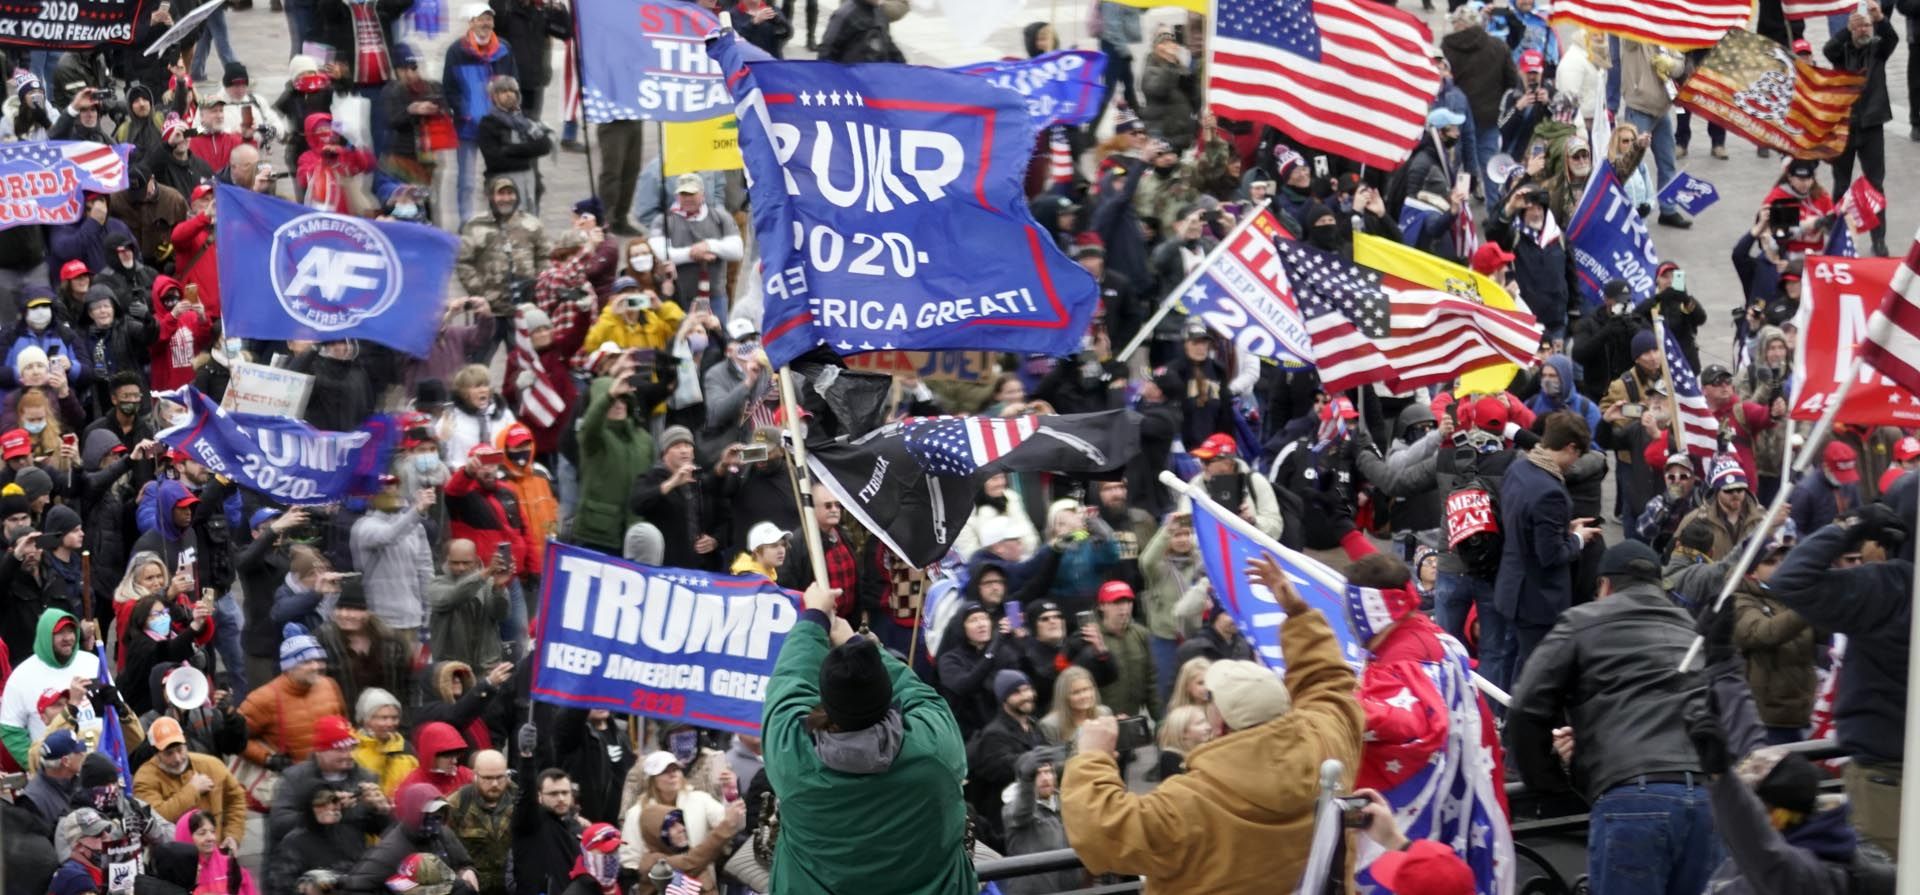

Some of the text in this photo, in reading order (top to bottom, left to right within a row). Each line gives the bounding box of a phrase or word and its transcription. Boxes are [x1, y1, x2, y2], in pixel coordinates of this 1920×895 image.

[38, 1, 79, 21] 2020
[21, 20, 64, 40] YOUR
[66, 24, 131, 41] FEELINGS
[638, 79, 735, 112] STEA
[283, 246, 386, 302] AF
[1214, 256, 1256, 296] KEEP
[1814, 262, 1854, 285] 45
[916, 288, 1037, 330] GREAT!
[1202, 296, 1303, 363] 20
[194, 437, 227, 473] KEEP
[560, 555, 797, 660] TRUMP
[547, 642, 602, 676] KEEP
[603, 654, 705, 692] AMERICA
[631, 689, 686, 717] 2020
